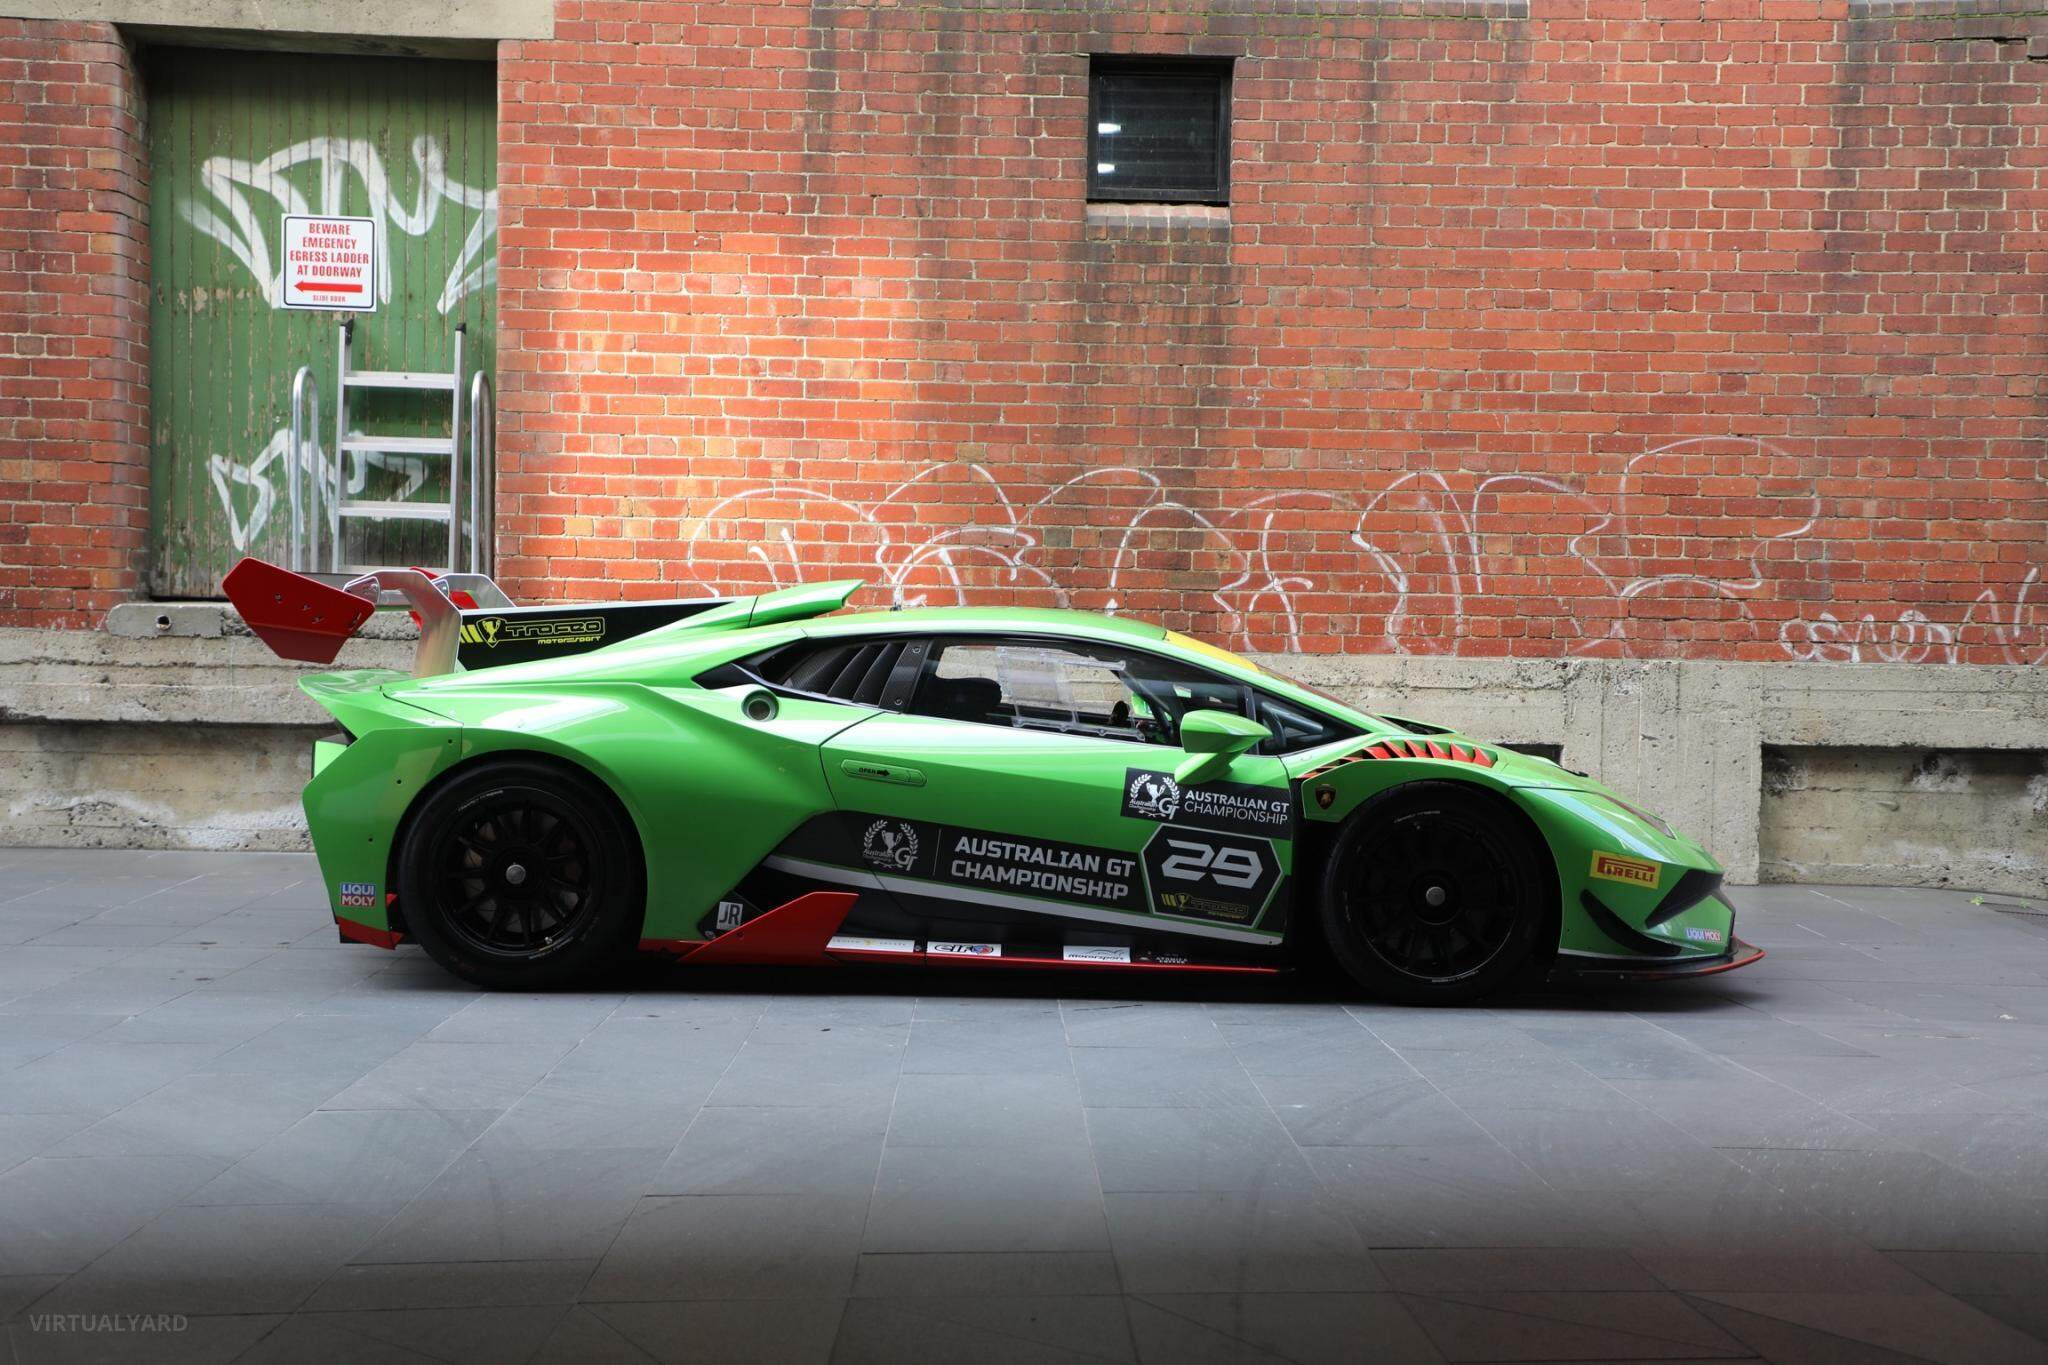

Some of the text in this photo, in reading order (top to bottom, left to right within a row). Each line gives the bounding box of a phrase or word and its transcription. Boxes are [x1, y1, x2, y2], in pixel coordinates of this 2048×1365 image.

[308, 222, 351, 235] BEWARE
[302, 236, 357, 249] EMEGENCY
[289, 250, 369, 264] EGRESS LADDER
[296, 264, 362, 278] AT DOORWAY
[1158, 797, 1180, 820] GT
[1184, 789, 1290, 814] AUSTRALIAN GT
[1184, 800, 1289, 825] CHAMPIONSHIP
[954, 835, 1136, 878] AUSTRALIAN GT
[1161, 839, 1264, 889] 29
[950, 859, 1130, 900] CHAMPIONSHIP
[1596, 856, 1657, 883] PIRELLI
[341, 883, 376, 896] LIQUI
[341, 894, 375, 906] MOLY
[718, 903, 742, 926] JR
